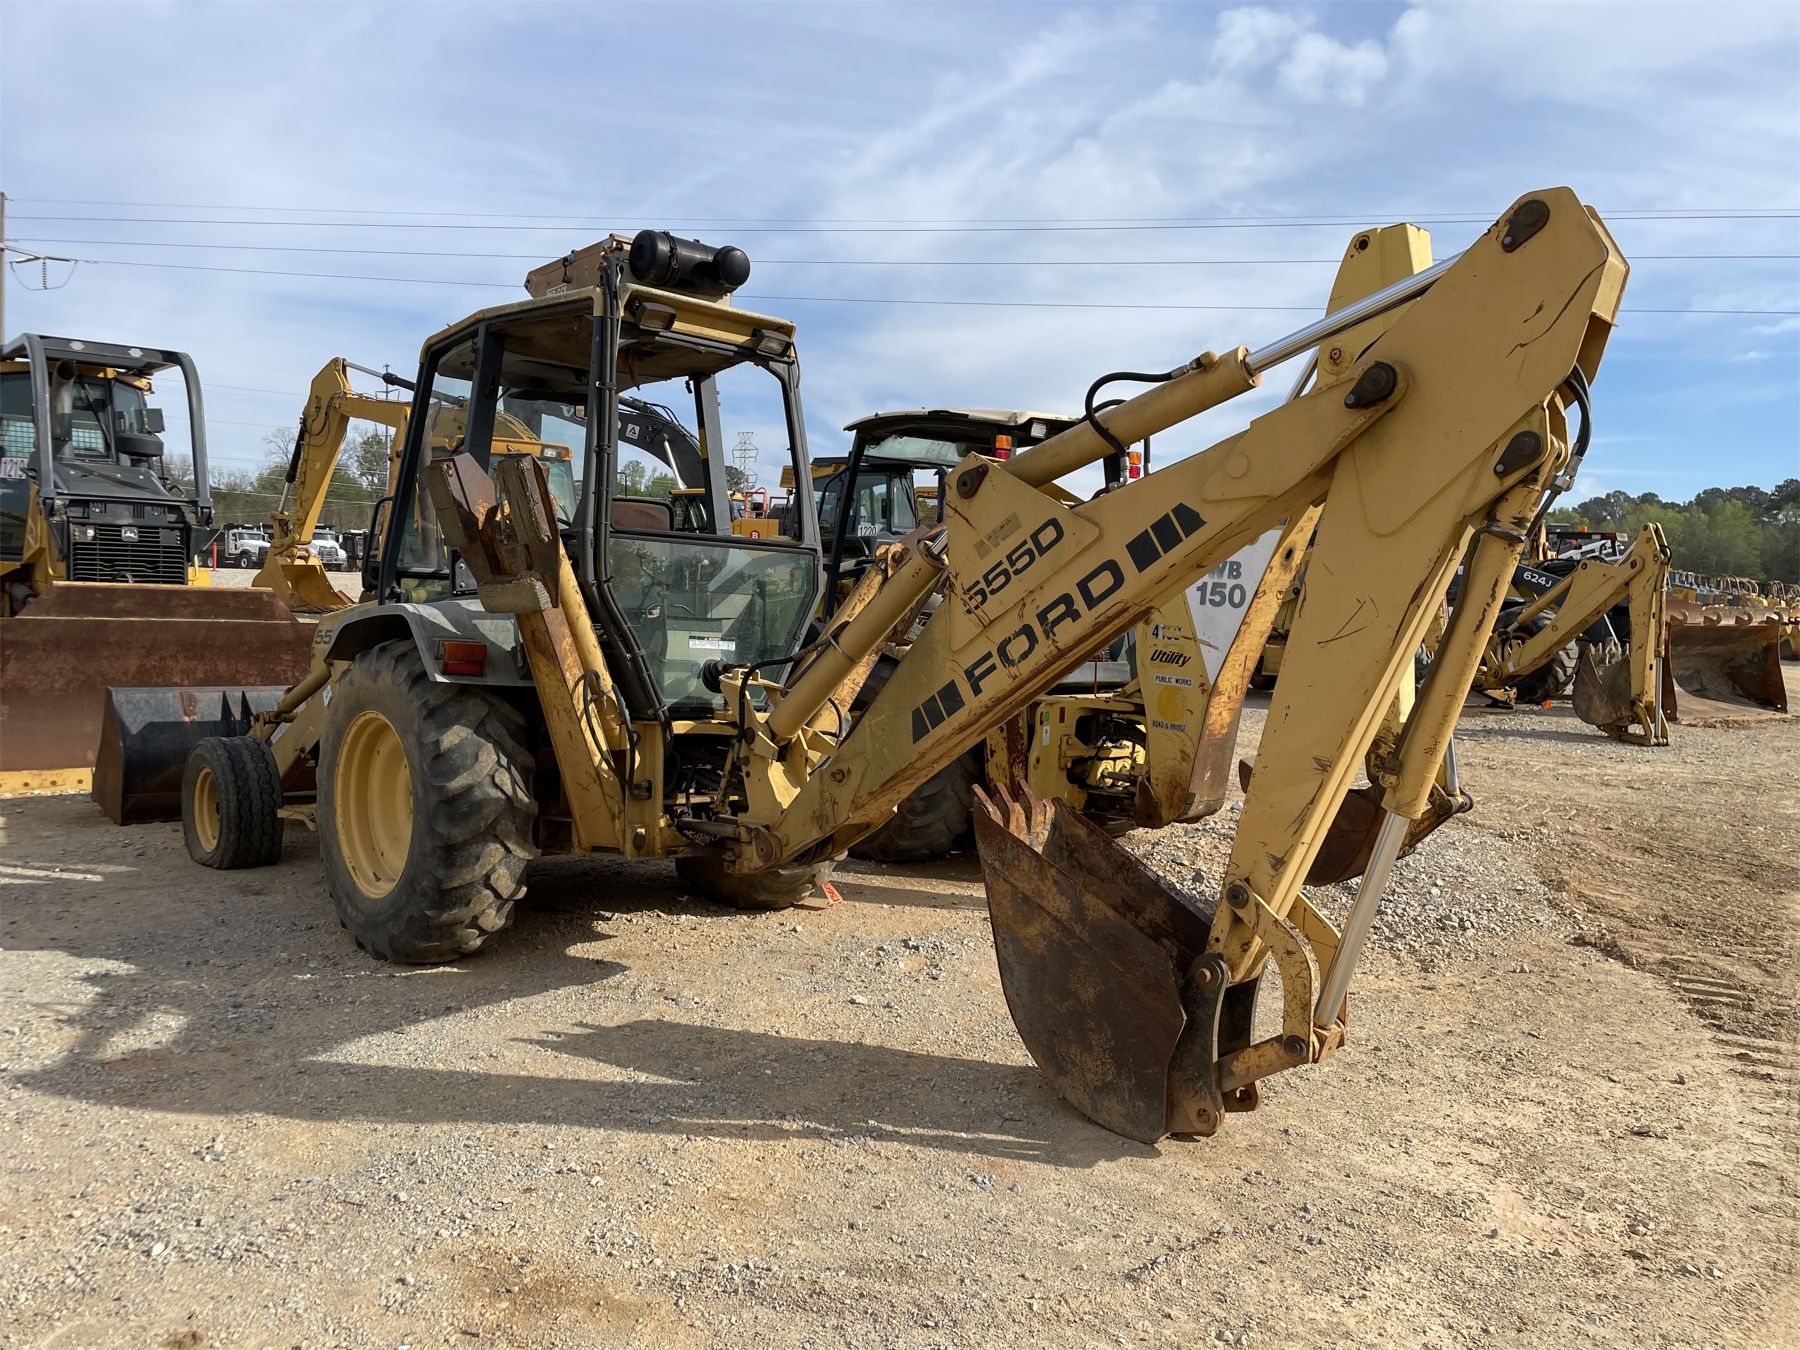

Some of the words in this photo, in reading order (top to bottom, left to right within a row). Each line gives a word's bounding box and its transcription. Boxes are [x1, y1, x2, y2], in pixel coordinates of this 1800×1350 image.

[965, 517, 1064, 615] 555D
[1523, 571, 1552, 588] 624J
[1196, 581, 1247, 609] 150
[963, 558, 1125, 698] FORD
[1150, 649, 1191, 668] Utility
[1155, 674, 1173, 684] PUBLIC
[1175, 677, 1192, 687] WORKS
[1152, 720, 1165, 729] ROAD
[1169, 722, 1186, 733] BRIDGE
